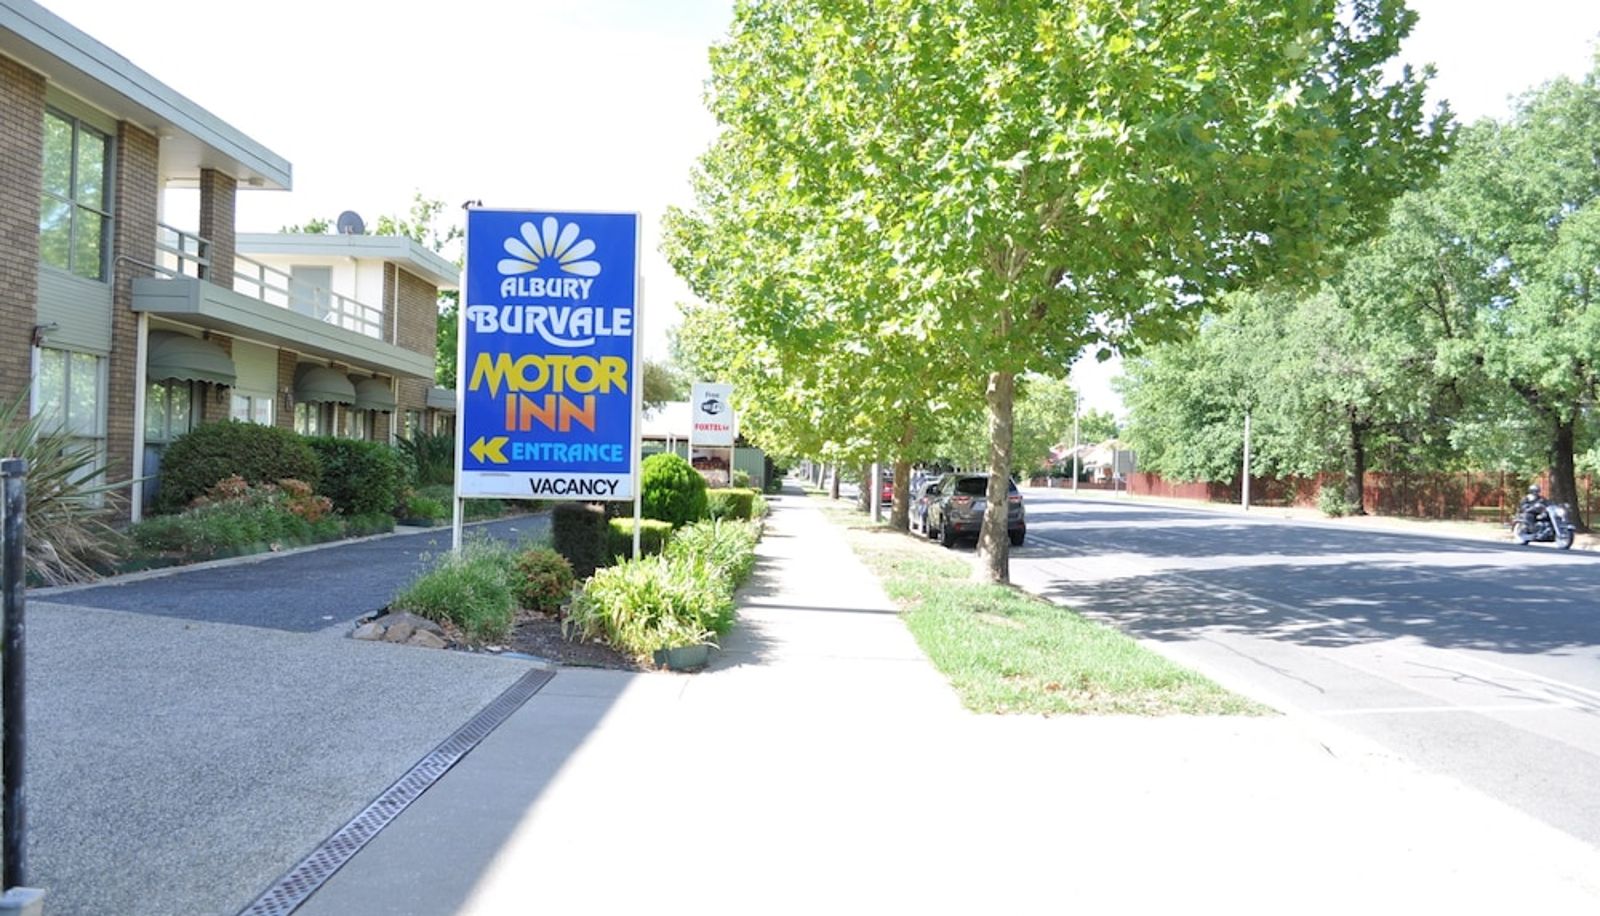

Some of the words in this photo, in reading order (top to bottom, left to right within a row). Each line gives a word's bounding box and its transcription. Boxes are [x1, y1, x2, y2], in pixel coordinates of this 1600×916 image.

[501, 277, 593, 299] ALBURY
[467, 304, 632, 347] BURVALE
[468, 352, 628, 399] MOTOR
[505, 393, 596, 432] INN
[512, 442, 624, 463] ENTRANCE
[529, 478, 619, 496] VACANCY
